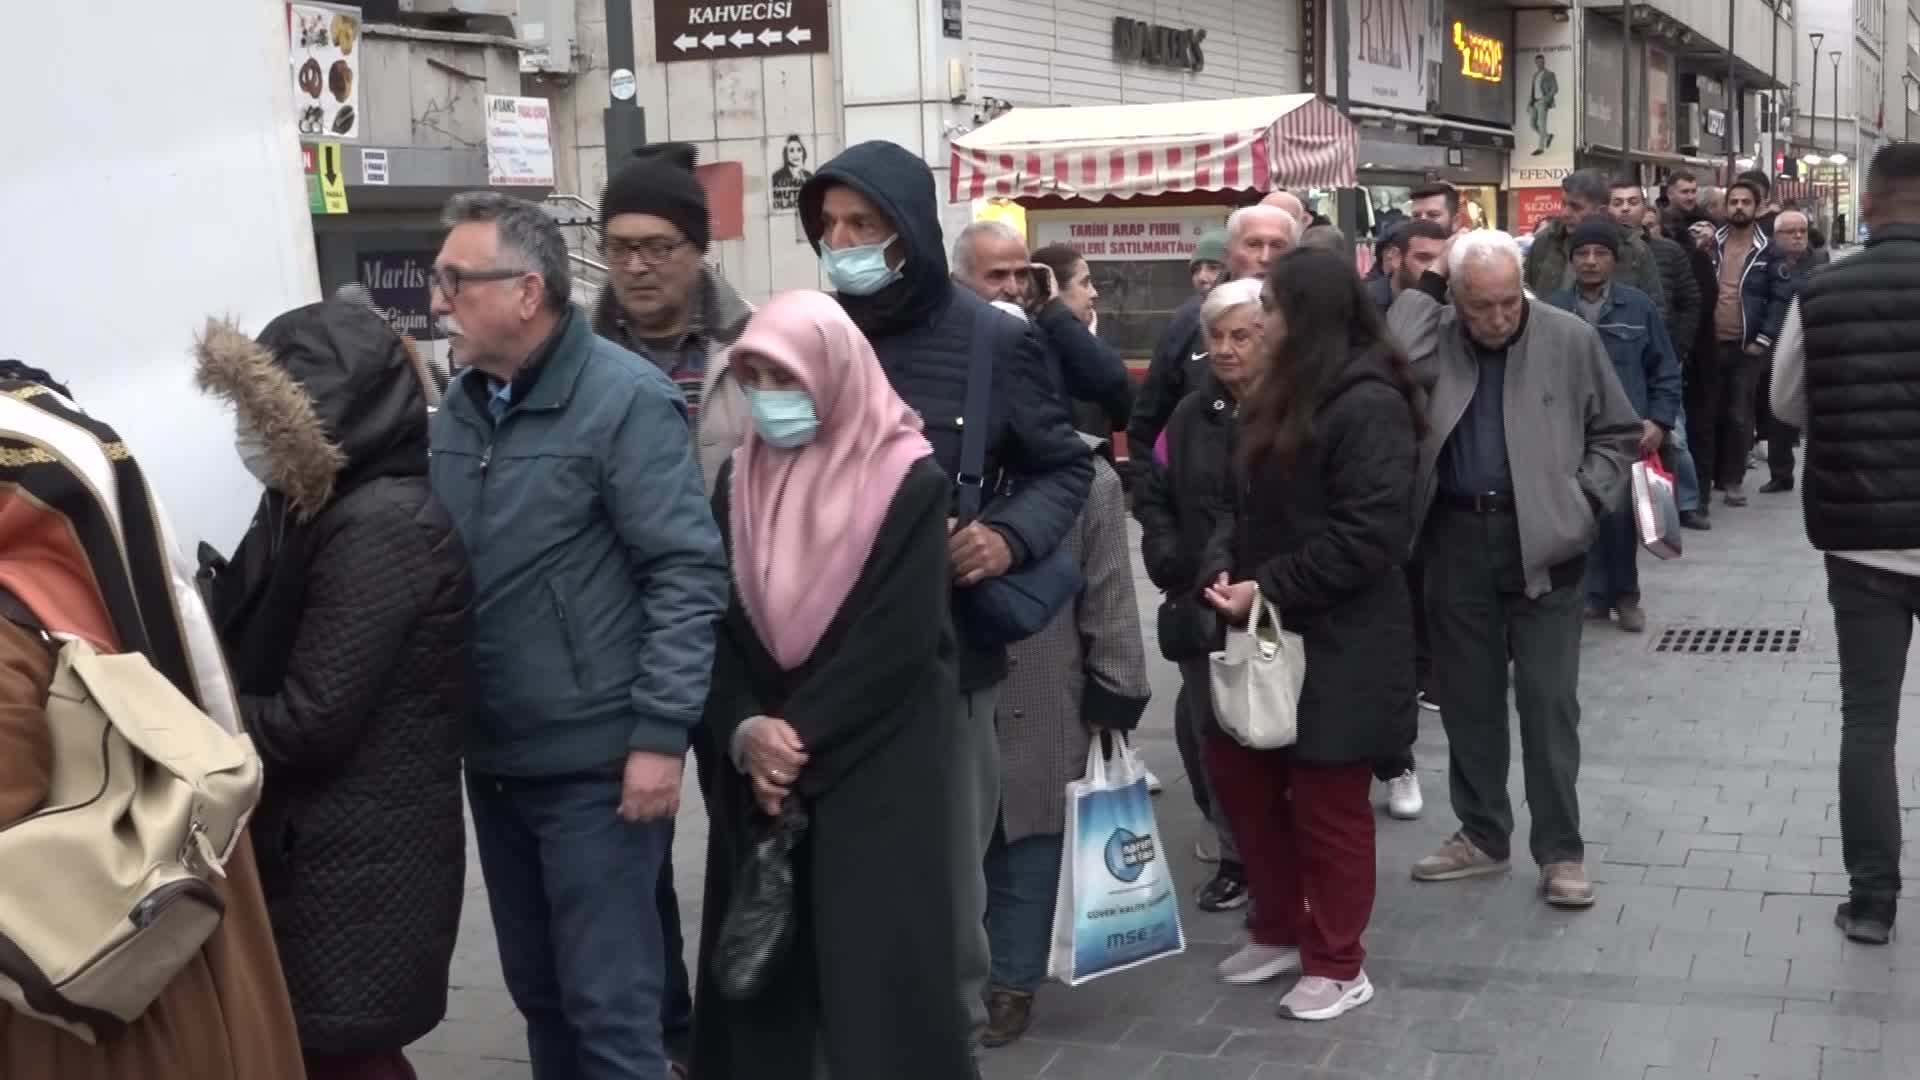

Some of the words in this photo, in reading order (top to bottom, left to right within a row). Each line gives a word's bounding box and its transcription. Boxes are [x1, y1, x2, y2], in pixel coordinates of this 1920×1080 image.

[688, 2, 793, 25] KAHVECİSİ
[1519, 167, 1573, 181] EFENDY
[1524, 201, 1563, 212] SEZON
[1112, 223, 1145, 237] ARAP
[1149, 222, 1181, 236] FIRIN
[362, 260, 425, 289] Marlis
